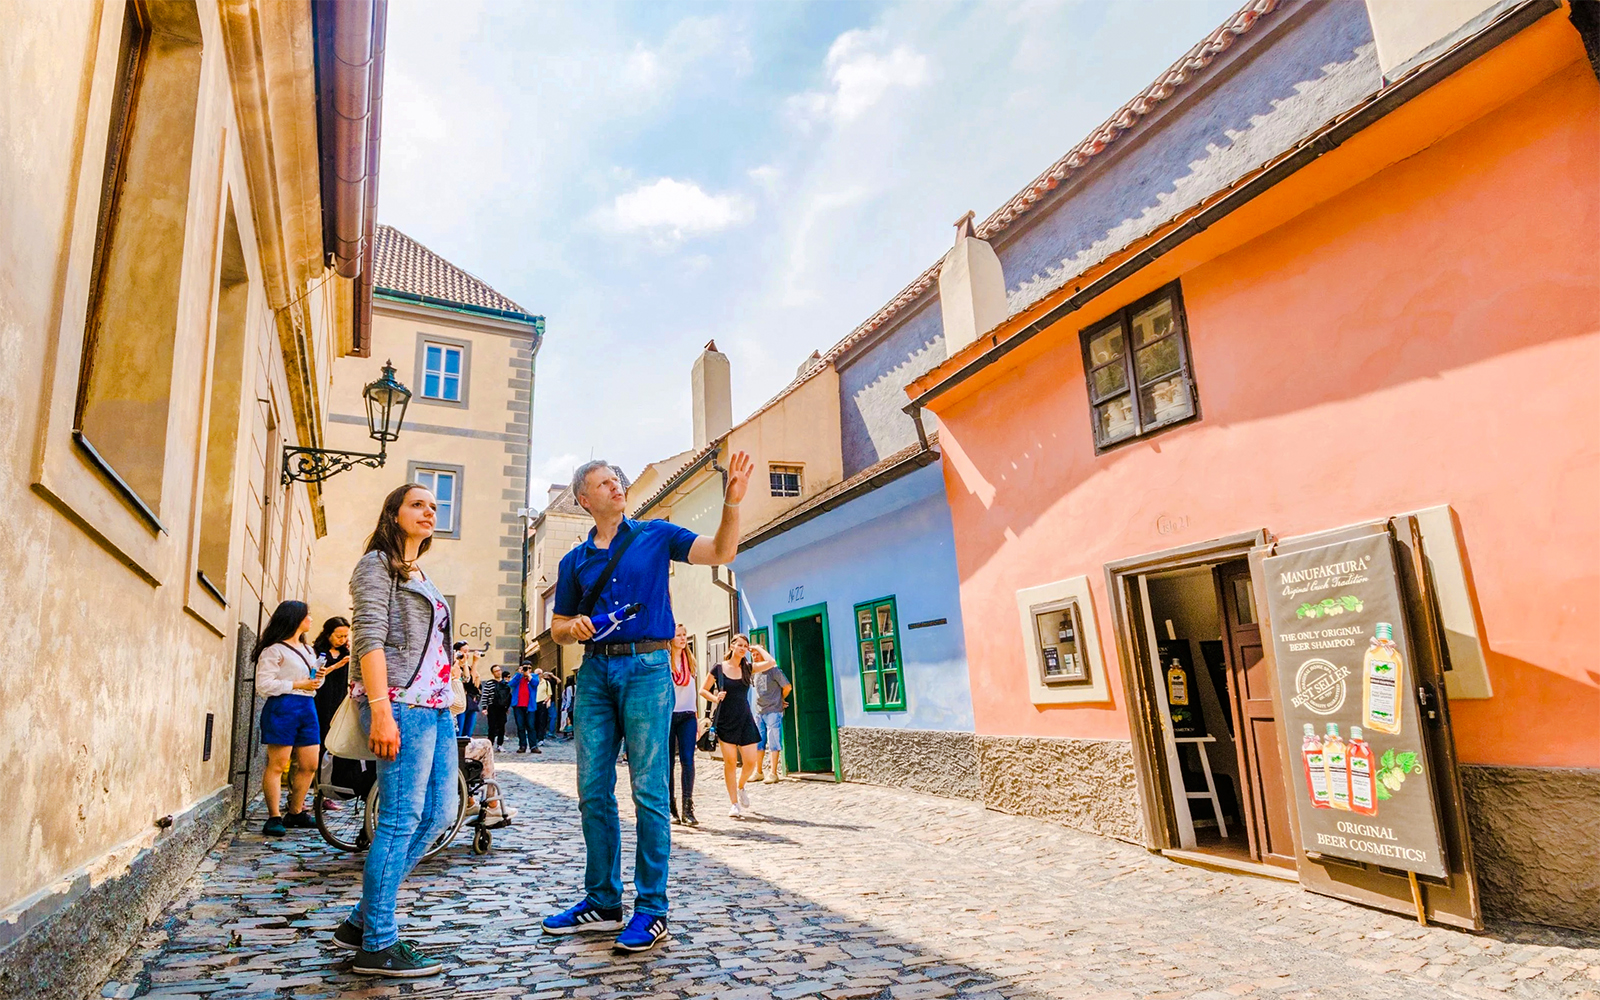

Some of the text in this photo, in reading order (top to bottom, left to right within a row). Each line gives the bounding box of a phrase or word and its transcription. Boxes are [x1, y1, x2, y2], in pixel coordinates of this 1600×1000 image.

[1282, 582, 1310, 600] Original
[1331, 573, 1369, 588] Tradition
[459, 621, 493, 641] Café
[1279, 625, 1364, 642] THE ONLY ORIGINAL
[1289, 638, 1356, 652] BEER SHAMPOO!
[1291, 687, 1315, 708] BEST
[1313, 665, 1352, 694] SELLER
[1336, 820, 1398, 841] ORIGINAL
[1316, 832, 1427, 863] BEER COSMETICS!
